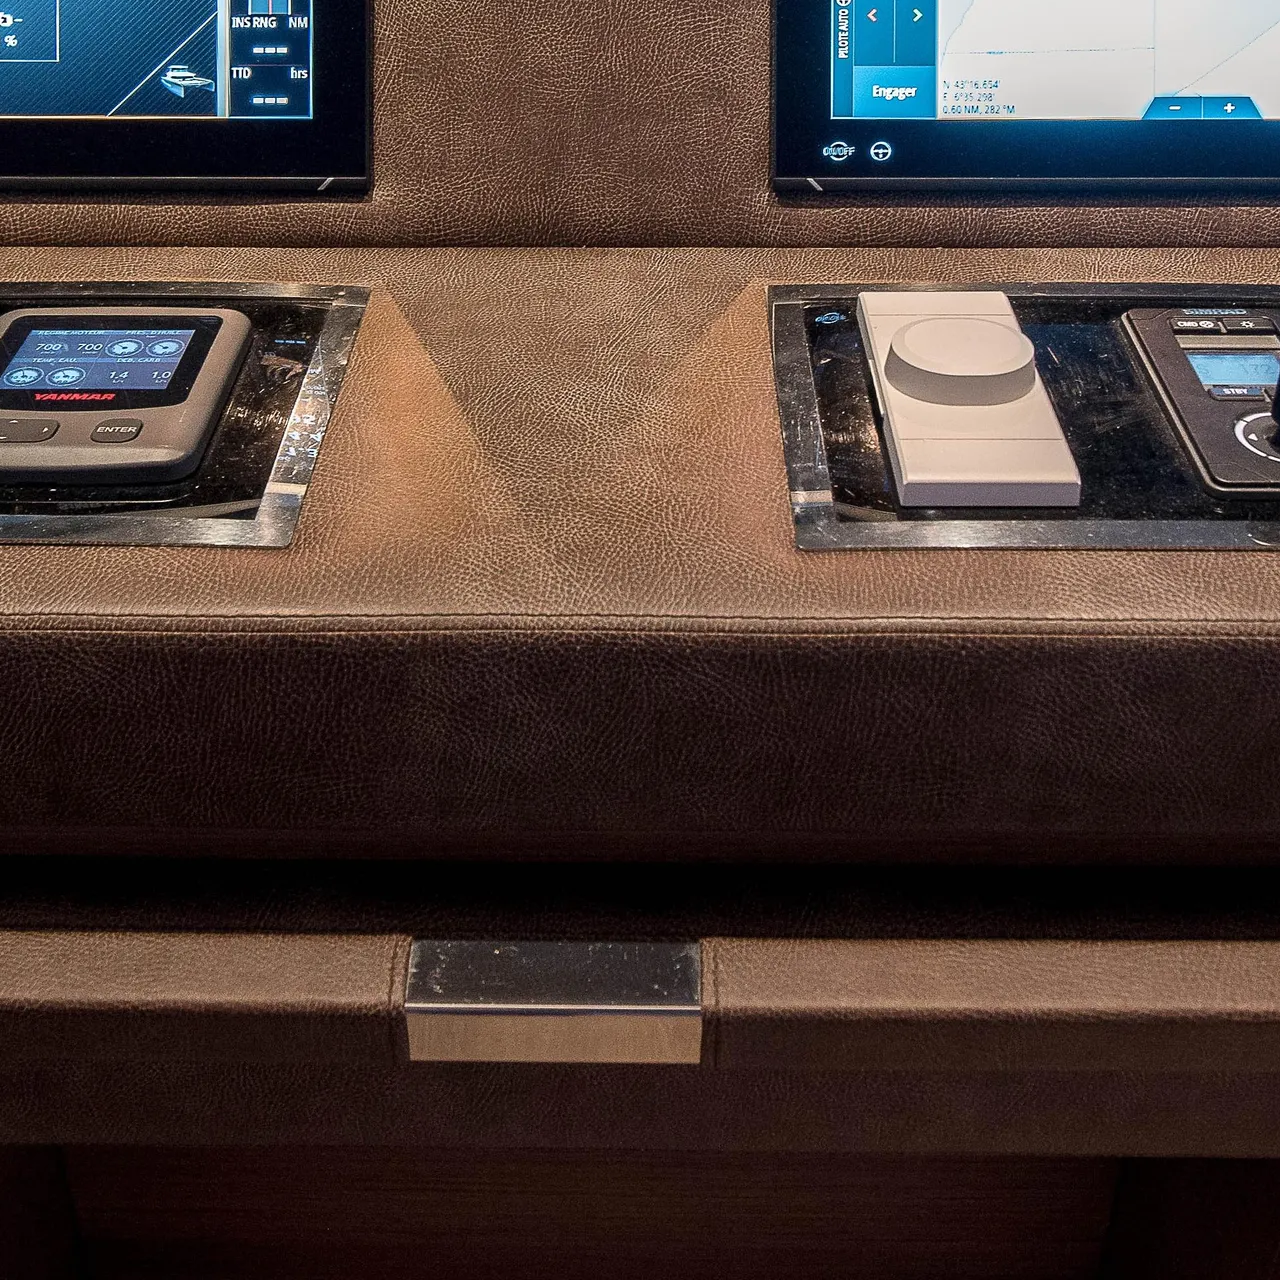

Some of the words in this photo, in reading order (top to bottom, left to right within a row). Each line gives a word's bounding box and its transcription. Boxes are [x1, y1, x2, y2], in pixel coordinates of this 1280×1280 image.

[231, 16, 251, 28] INS
[252, 16, 277, 28] RNG
[288, 16, 308, 28] NM
[838, 8, 848, 31] AUTO
[838, 31, 848, 59] PILOTE
[231, 67, 251, 79] TTD
[290, 66, 308, 79] hrs
[872, 85, 918, 101] Engager
[984, 105, 1000, 114] 282
[35, 343, 62, 351] 700
[77, 343, 104, 351] 700
[109, 371, 129, 379] 1.4
[151, 371, 171, 379] 1.0
[34, 393, 116, 401] YANMAR
